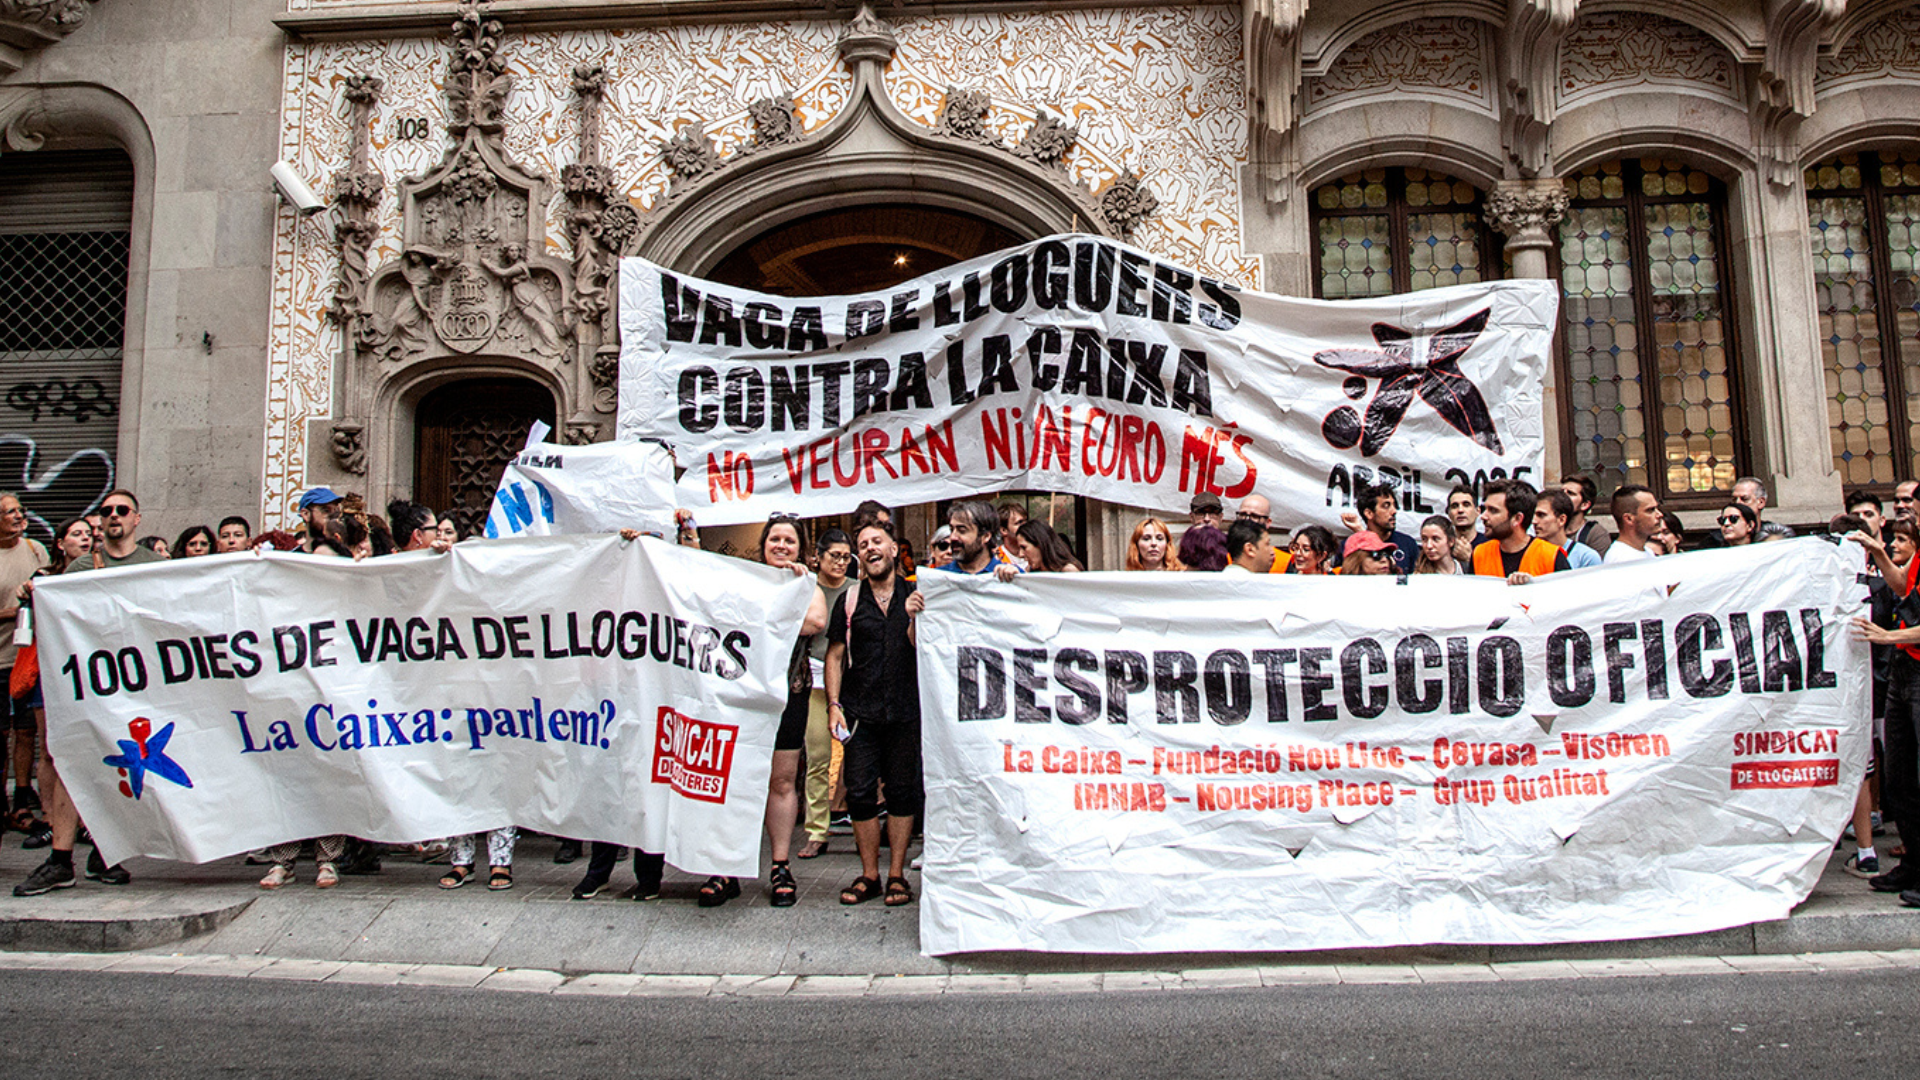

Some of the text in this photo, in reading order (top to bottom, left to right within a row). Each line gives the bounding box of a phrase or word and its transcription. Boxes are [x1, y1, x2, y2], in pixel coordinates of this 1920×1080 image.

[396, 118, 428, 139] 108
[660, 240, 1241, 351] VAGA DE LLOGUERS
[677, 325, 1213, 434] CONTRA LA CAIXA
[707, 450, 755, 503] NO
[782, 418, 960, 495] VEURAN
[1081, 407, 1166, 485] EURO
[1178, 421, 1257, 499] MÉS
[62, 610, 751, 700] 100 DIES DE VAGA DE LLOGUERS
[957, 608, 1837, 726] DESPROTECCIÓ OFICIAL
[230, 697, 616, 754] La Caixa: parlem?
[1733, 729, 1839, 756] SINDICAT
[1003, 744, 1034, 773] La
[1042, 745, 1122, 775] Caixa
[1153, 743, 1281, 776] Fundació
[1433, 737, 1538, 769] Cevasa
[1737, 766, 1836, 784] DE LLOGATERES
[1318, 779, 1394, 807] Place
[1433, 776, 1496, 807] Grup
[1503, 768, 1610, 804] Qualitat
